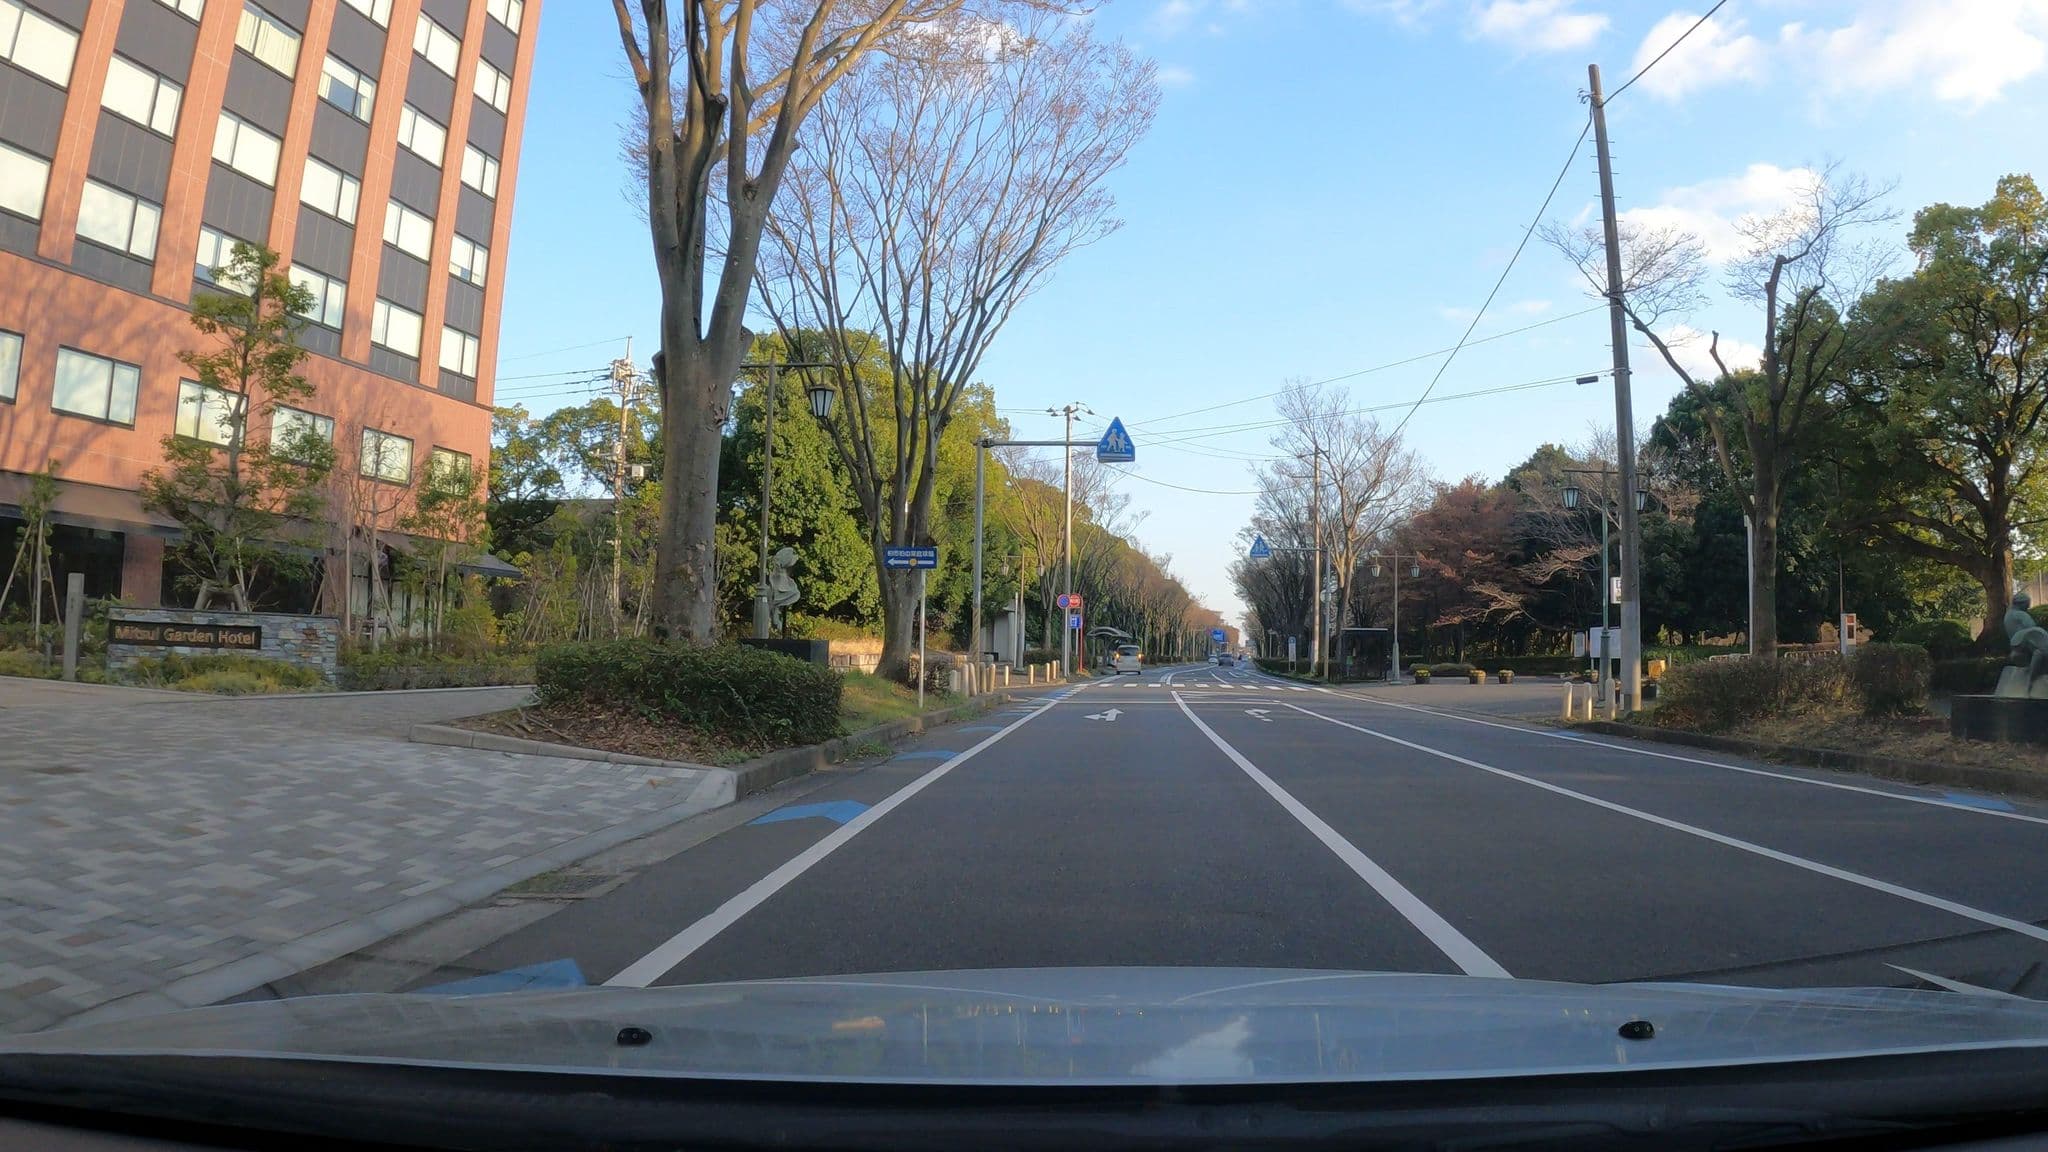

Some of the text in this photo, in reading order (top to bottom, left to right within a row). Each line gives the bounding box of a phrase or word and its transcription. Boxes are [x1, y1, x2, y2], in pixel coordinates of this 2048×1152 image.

[115, 626, 255, 645] Mitsui Garden Hotel
